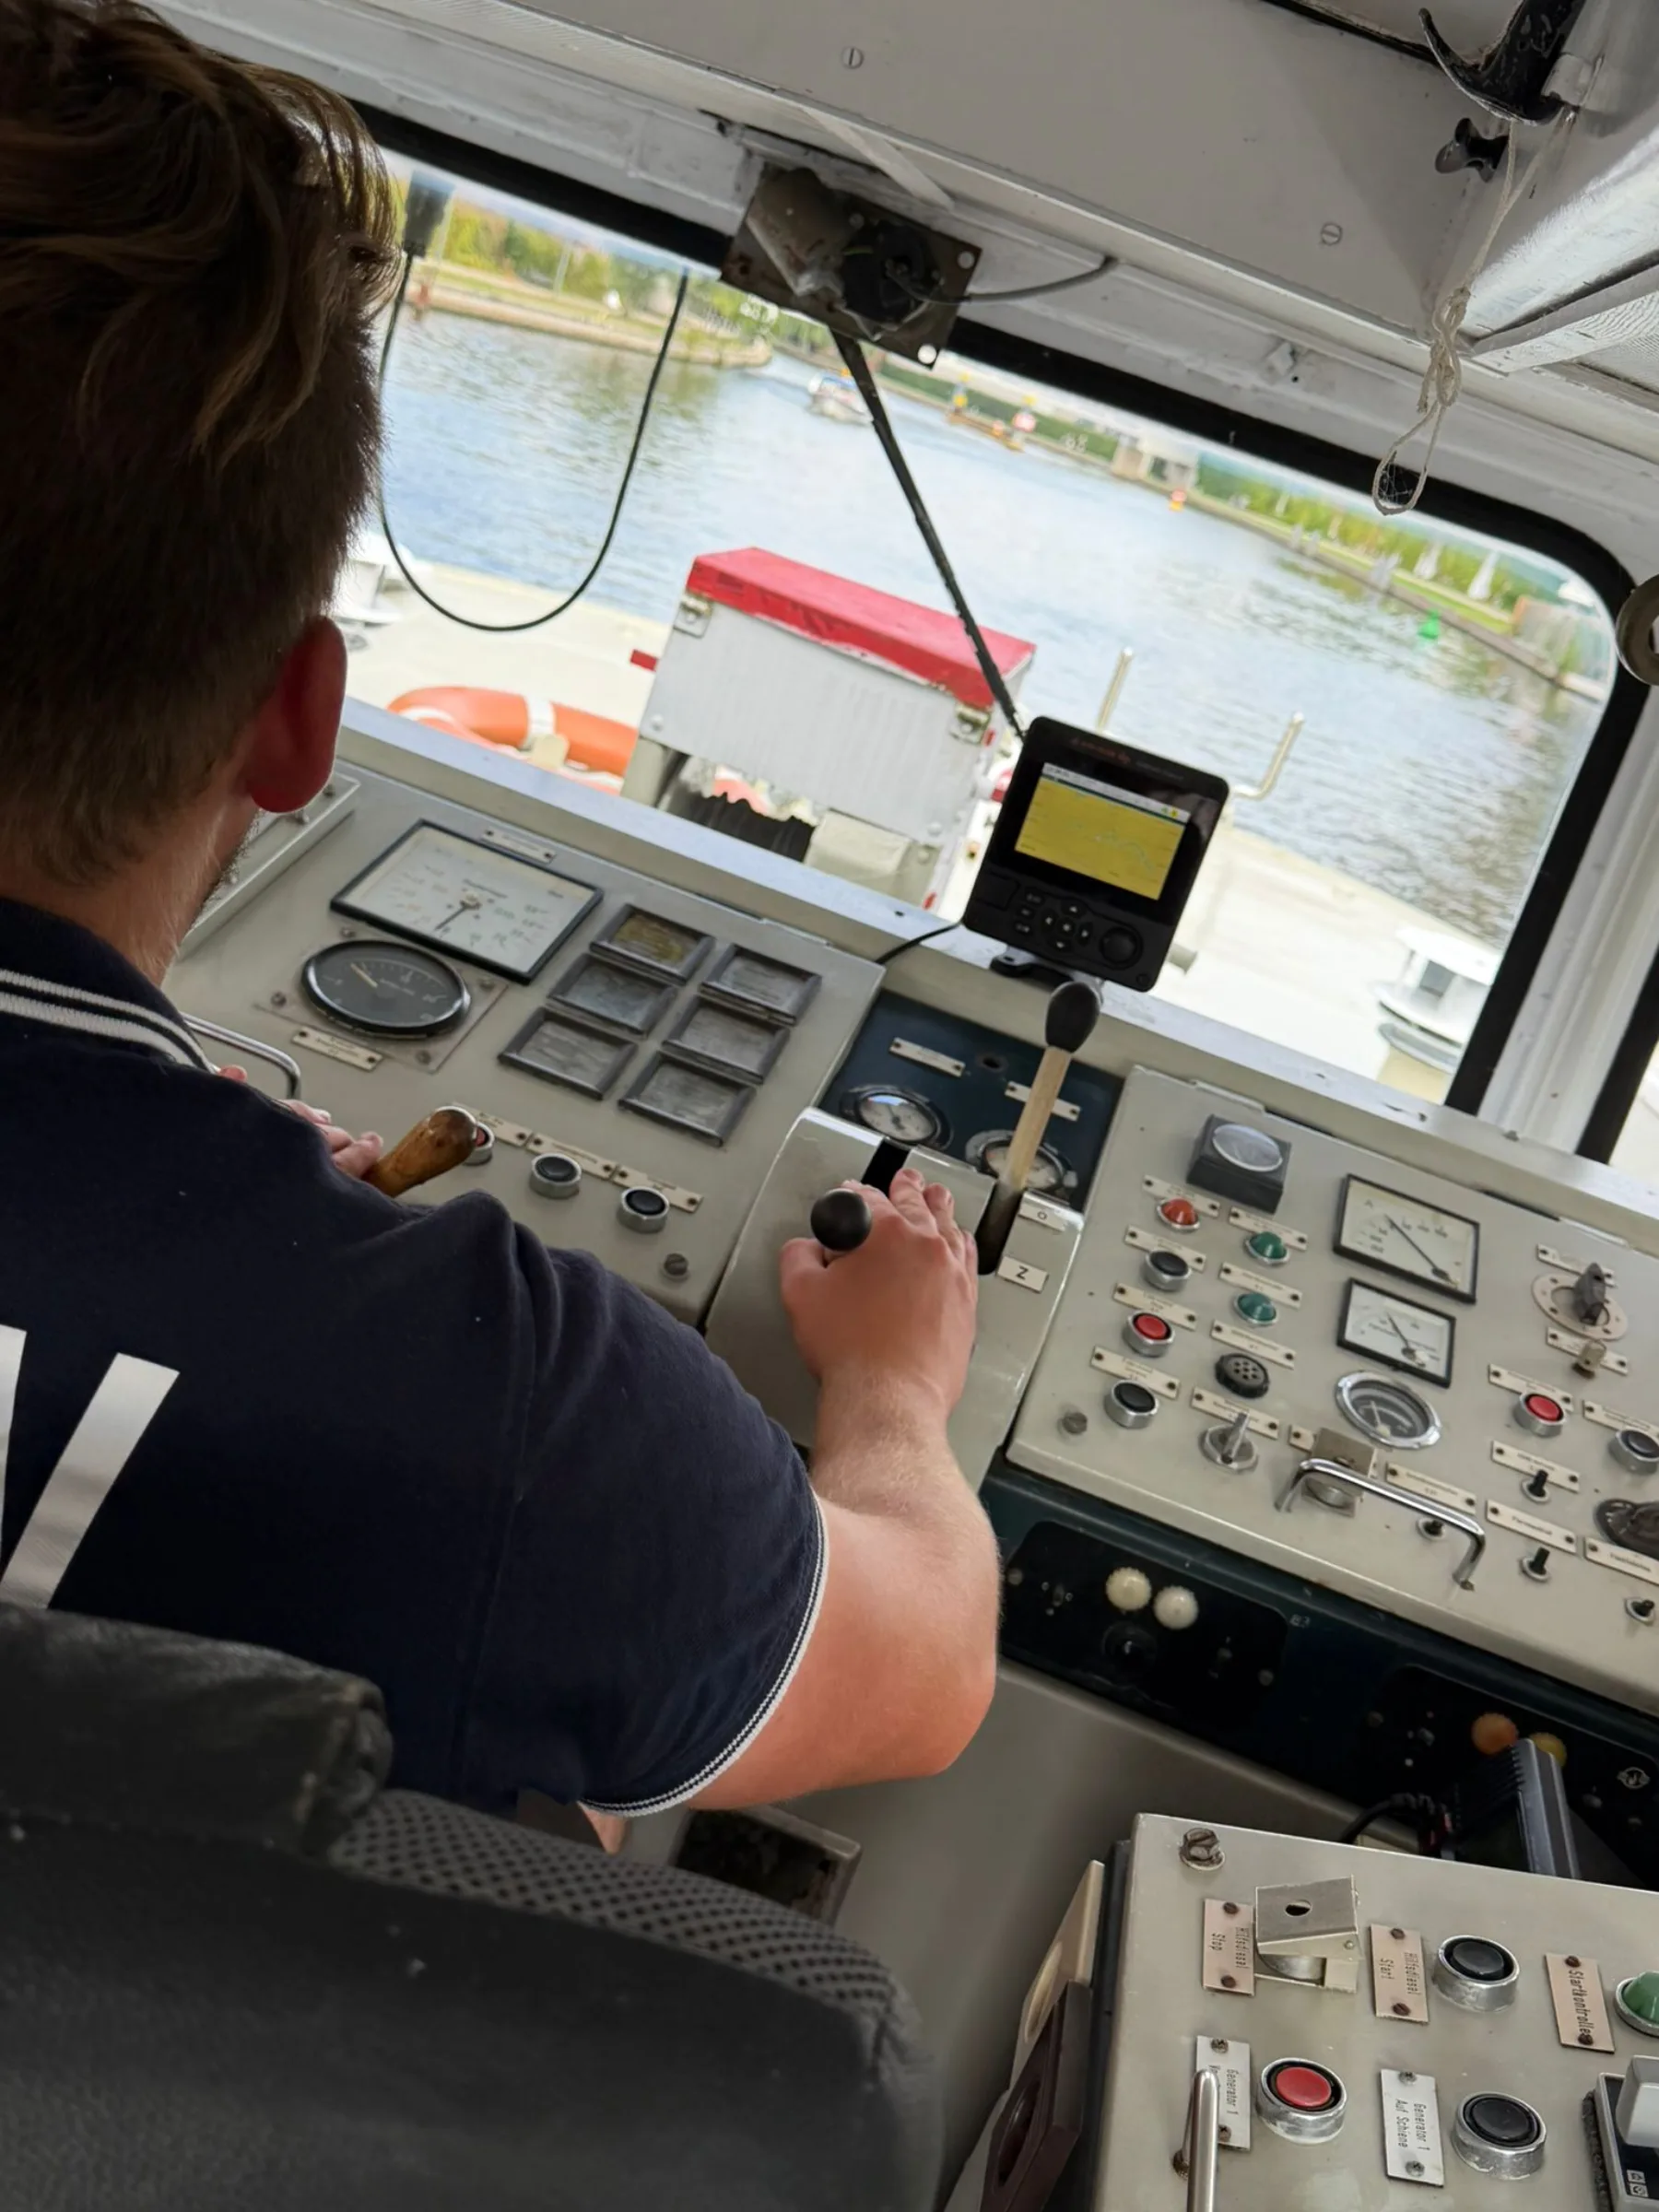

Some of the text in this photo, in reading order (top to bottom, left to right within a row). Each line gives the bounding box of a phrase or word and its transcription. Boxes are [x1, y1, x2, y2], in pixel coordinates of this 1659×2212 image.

[1016, 1265, 1029, 1280] Z
[1379, 1958, 1394, 1980] Start
[1568, 1970, 1594, 2035] Startkontrolle
[1226, 2068, 1239, 2107] Generator
[1395, 2099, 1411, 2148] Auf Schiene
[1414, 2103, 1427, 2143] Generator
